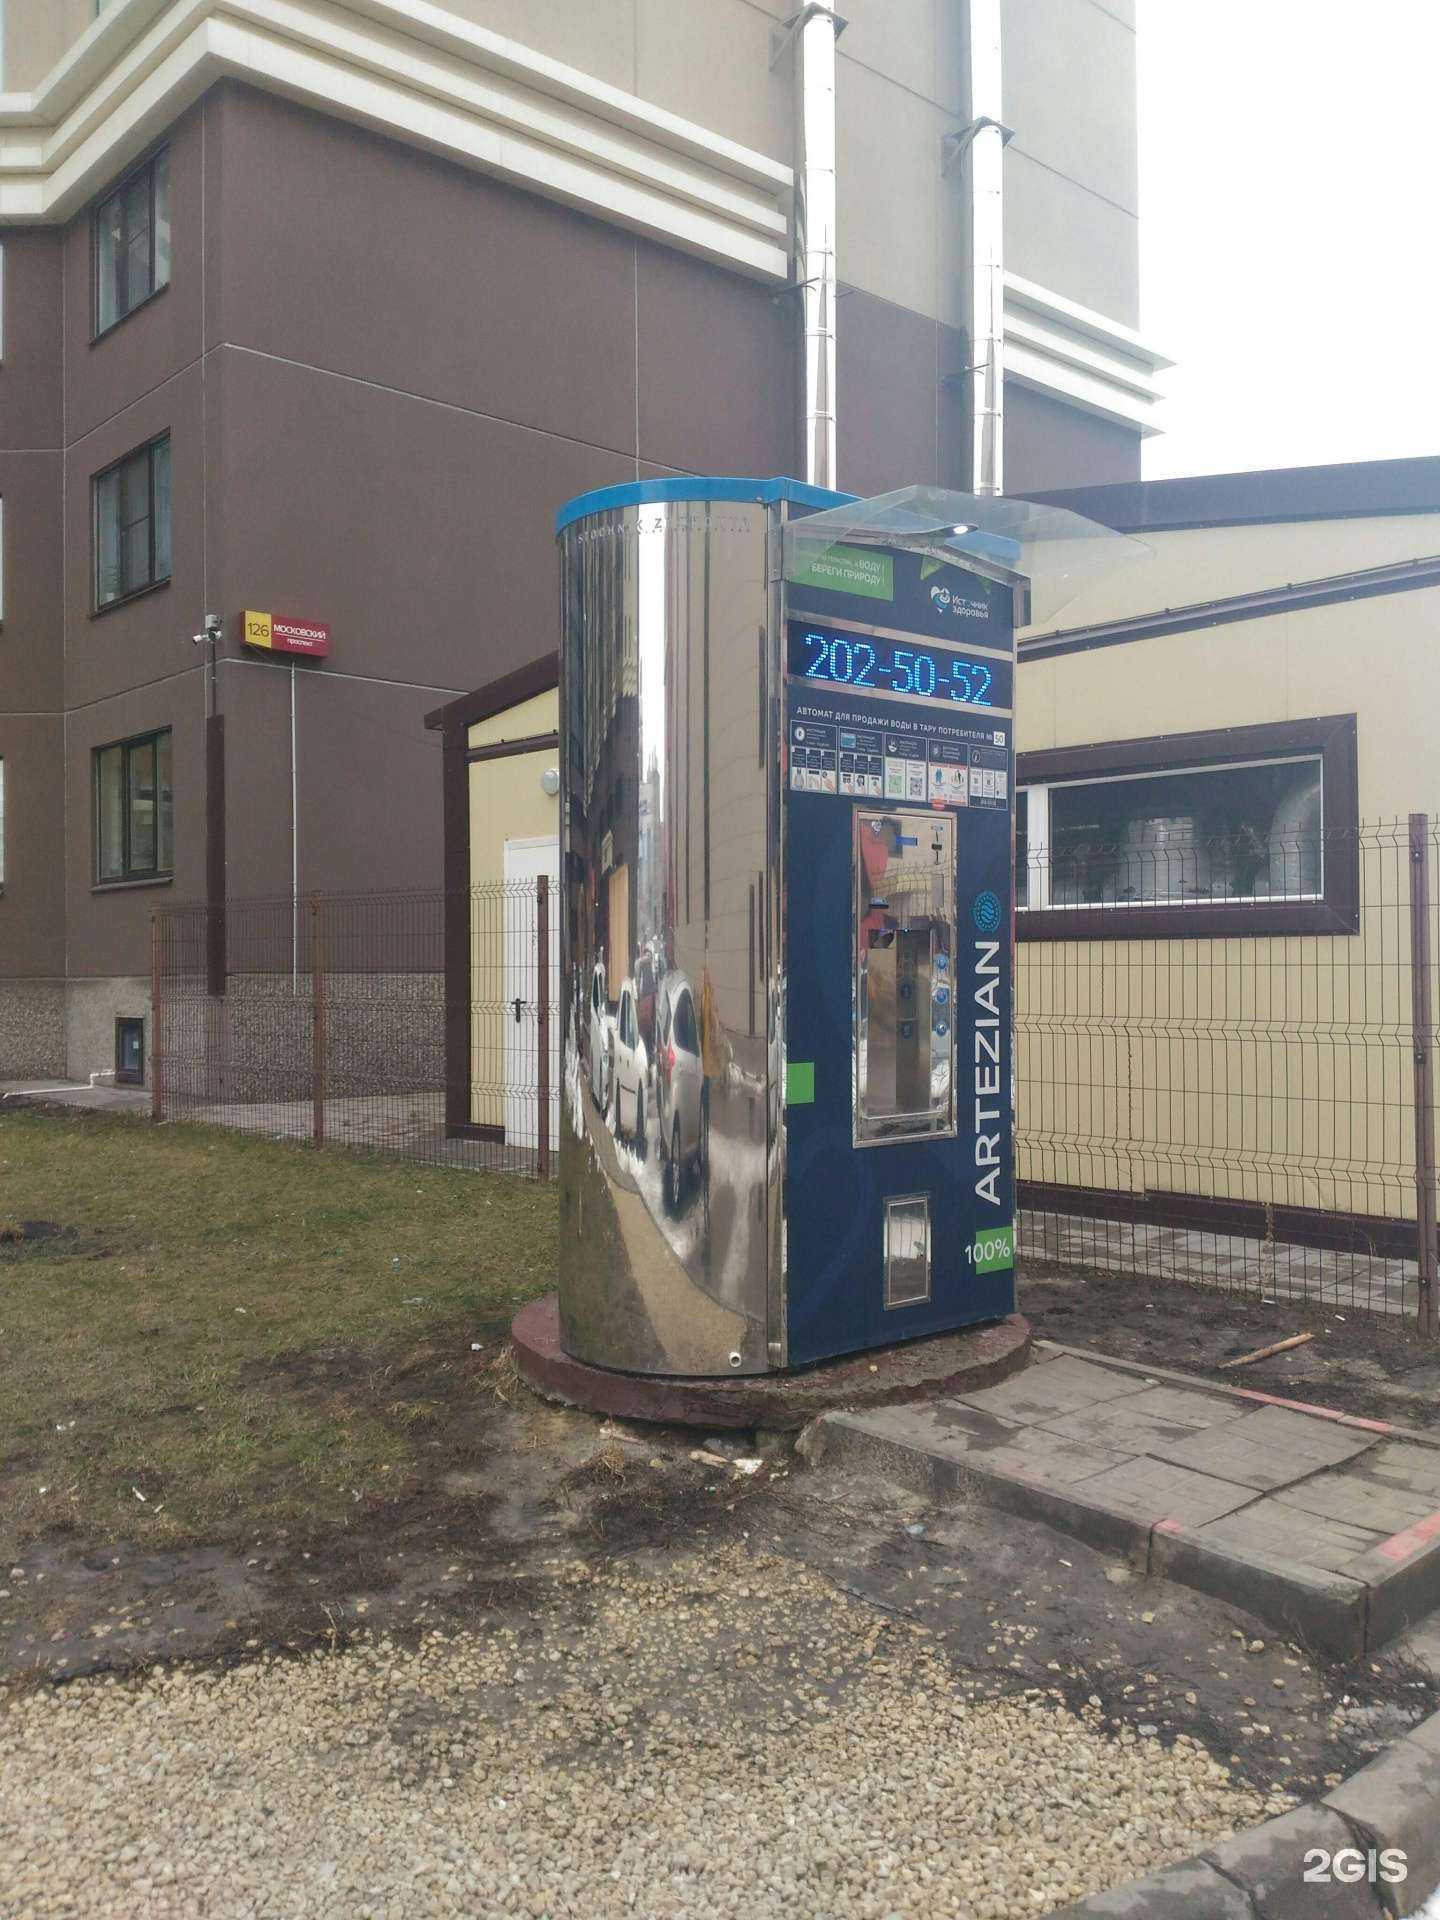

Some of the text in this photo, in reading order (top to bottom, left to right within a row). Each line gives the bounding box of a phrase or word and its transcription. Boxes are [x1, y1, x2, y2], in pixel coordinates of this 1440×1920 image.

[952, 595, 989, 610] Истчник
[248, 622, 270, 638] 126
[805, 633, 992, 707] 202-50-52
[796, 706, 833, 719] АВТОМАТ
[835, 712, 851, 721] ДЛЯ
[852, 714, 889, 726] ПРОДАЖИ
[890, 719, 912, 731] ВОДЫ
[913, 722, 918, 730] В
[919, 723, 937, 733] ТАРУ
[938, 726, 985, 740] ПОТРЕБИТЕЛЯ
[975, 941, 1000, 1206] ARTEZIAN
[965, 1238, 1010, 1265] 100%
